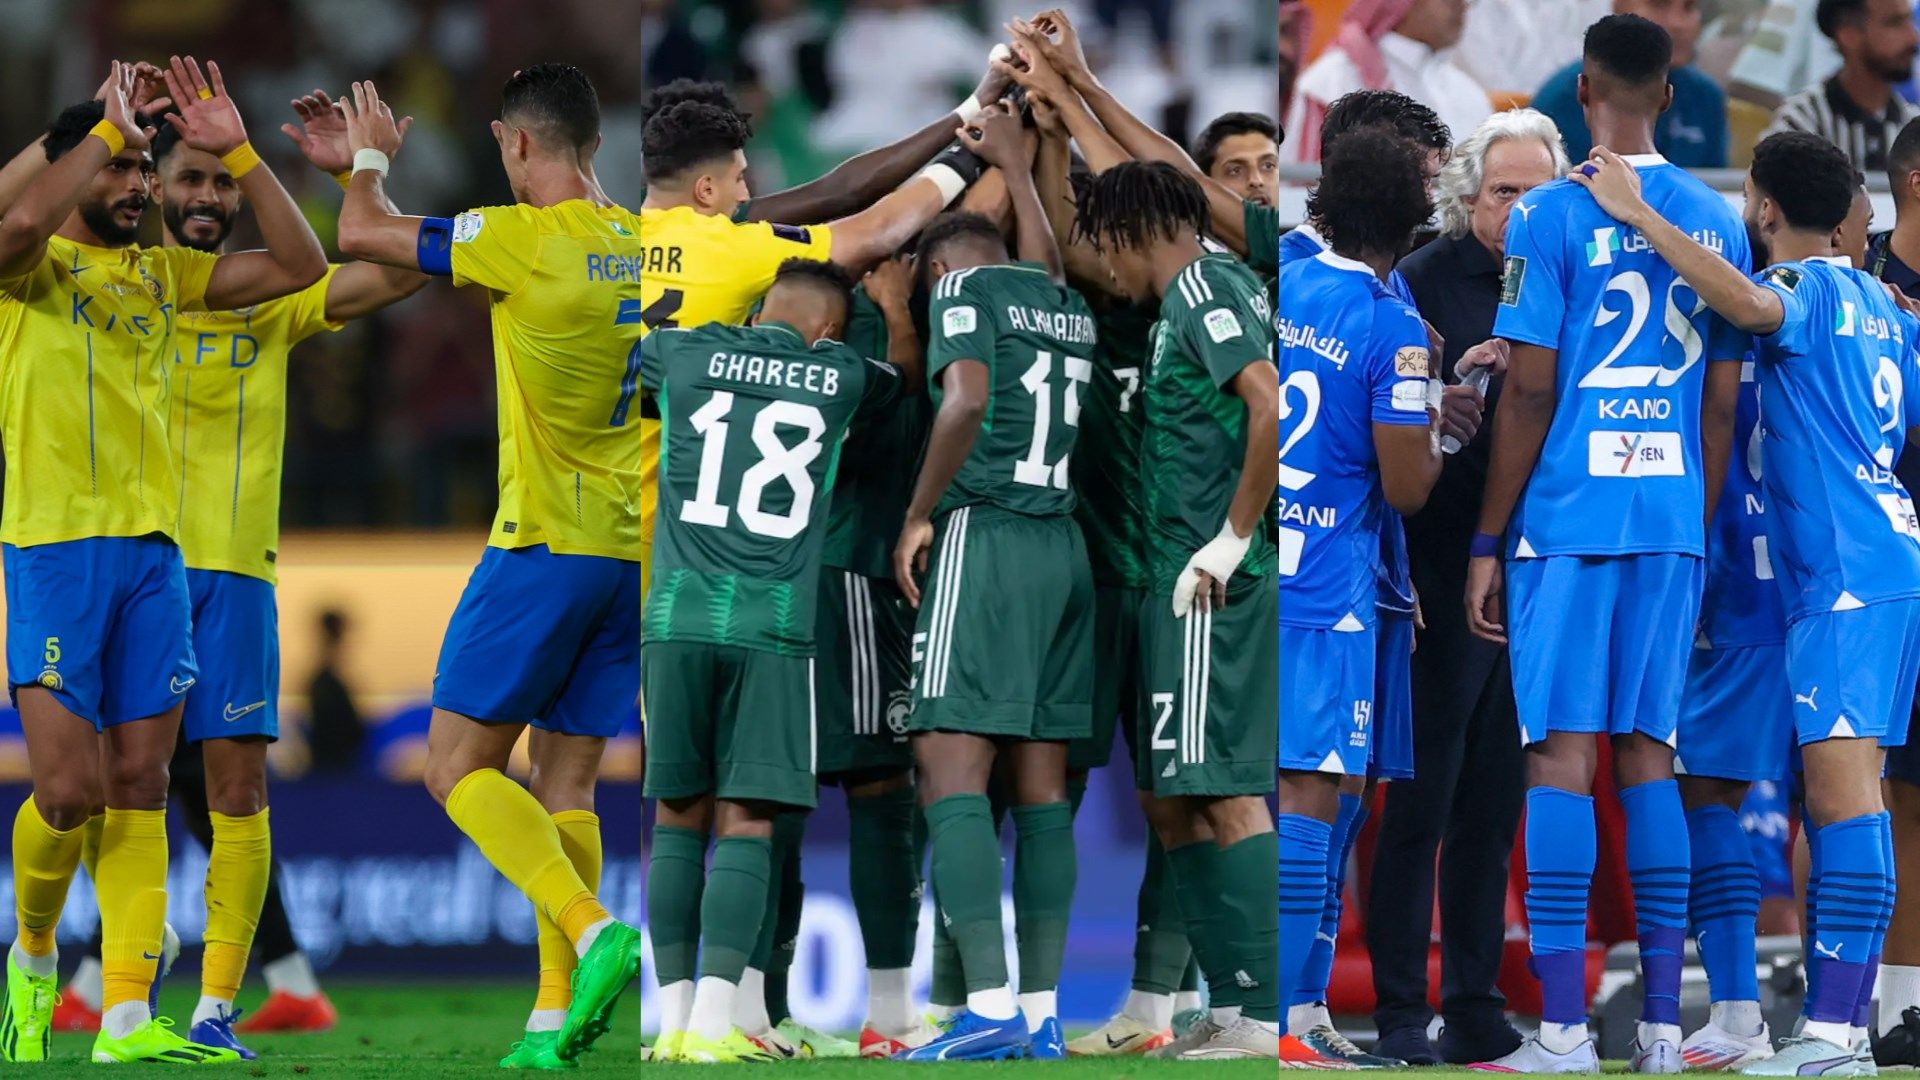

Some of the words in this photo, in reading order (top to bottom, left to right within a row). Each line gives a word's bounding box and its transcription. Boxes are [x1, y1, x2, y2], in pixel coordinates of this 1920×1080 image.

[641, 246, 683, 273] AR
[1578, 270, 1703, 388] 28
[708, 352, 840, 396] GHAREEB
[1311, 337, 1349, 371] بنك
[1112, 366, 1139, 412] 7
[1599, 398, 1670, 419] KANO
[679, 390, 827, 539] 18
[45, 637, 60, 663] 5
[1152, 693, 1177, 750] 2
